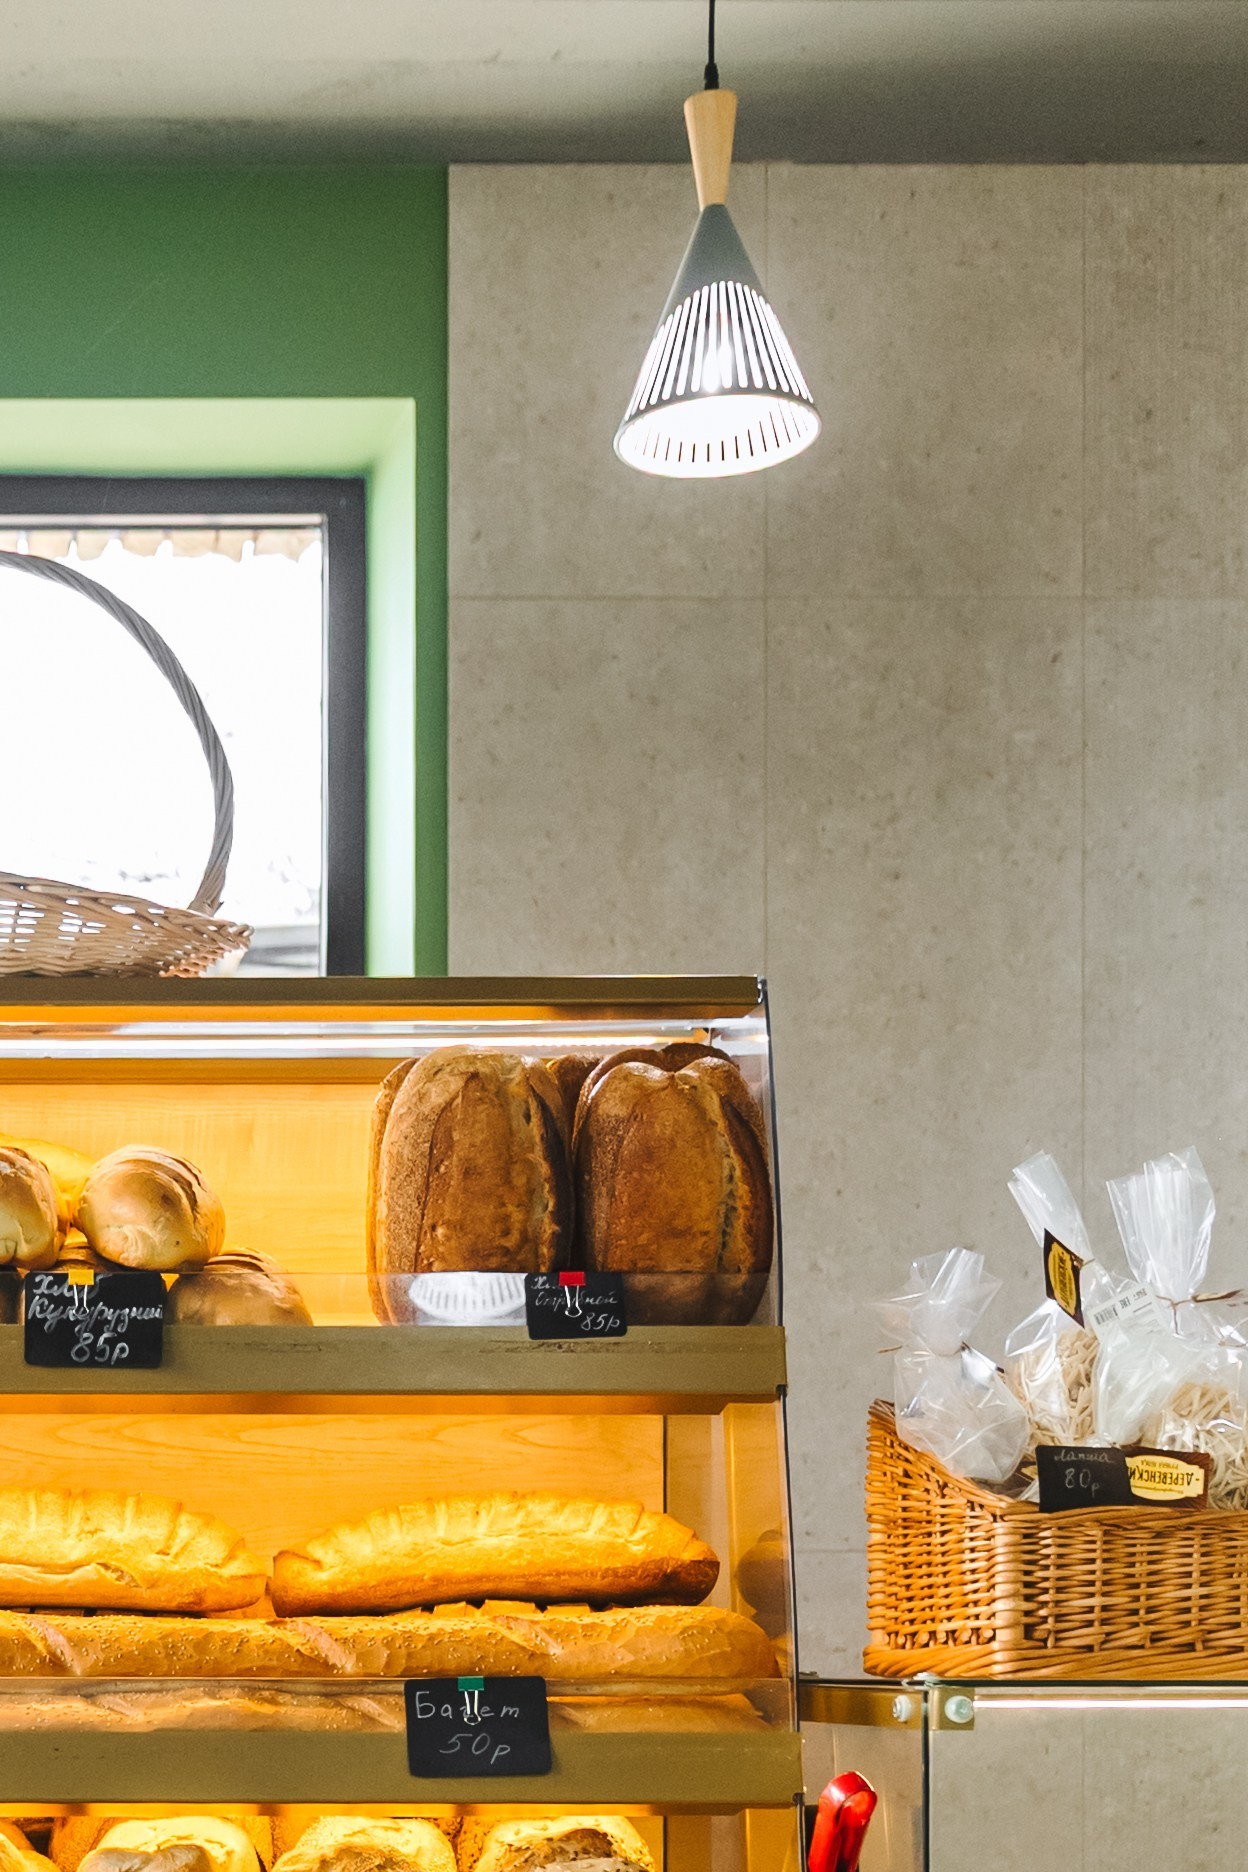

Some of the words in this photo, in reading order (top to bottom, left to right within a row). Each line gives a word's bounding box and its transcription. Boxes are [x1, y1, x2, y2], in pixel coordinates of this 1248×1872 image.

[581, 1312, 621, 1332] 85р
[70, 1332, 129, 1365] 85р
[415, 1691, 520, 1719] Багет
[439, 1733, 511, 1765] 50р
